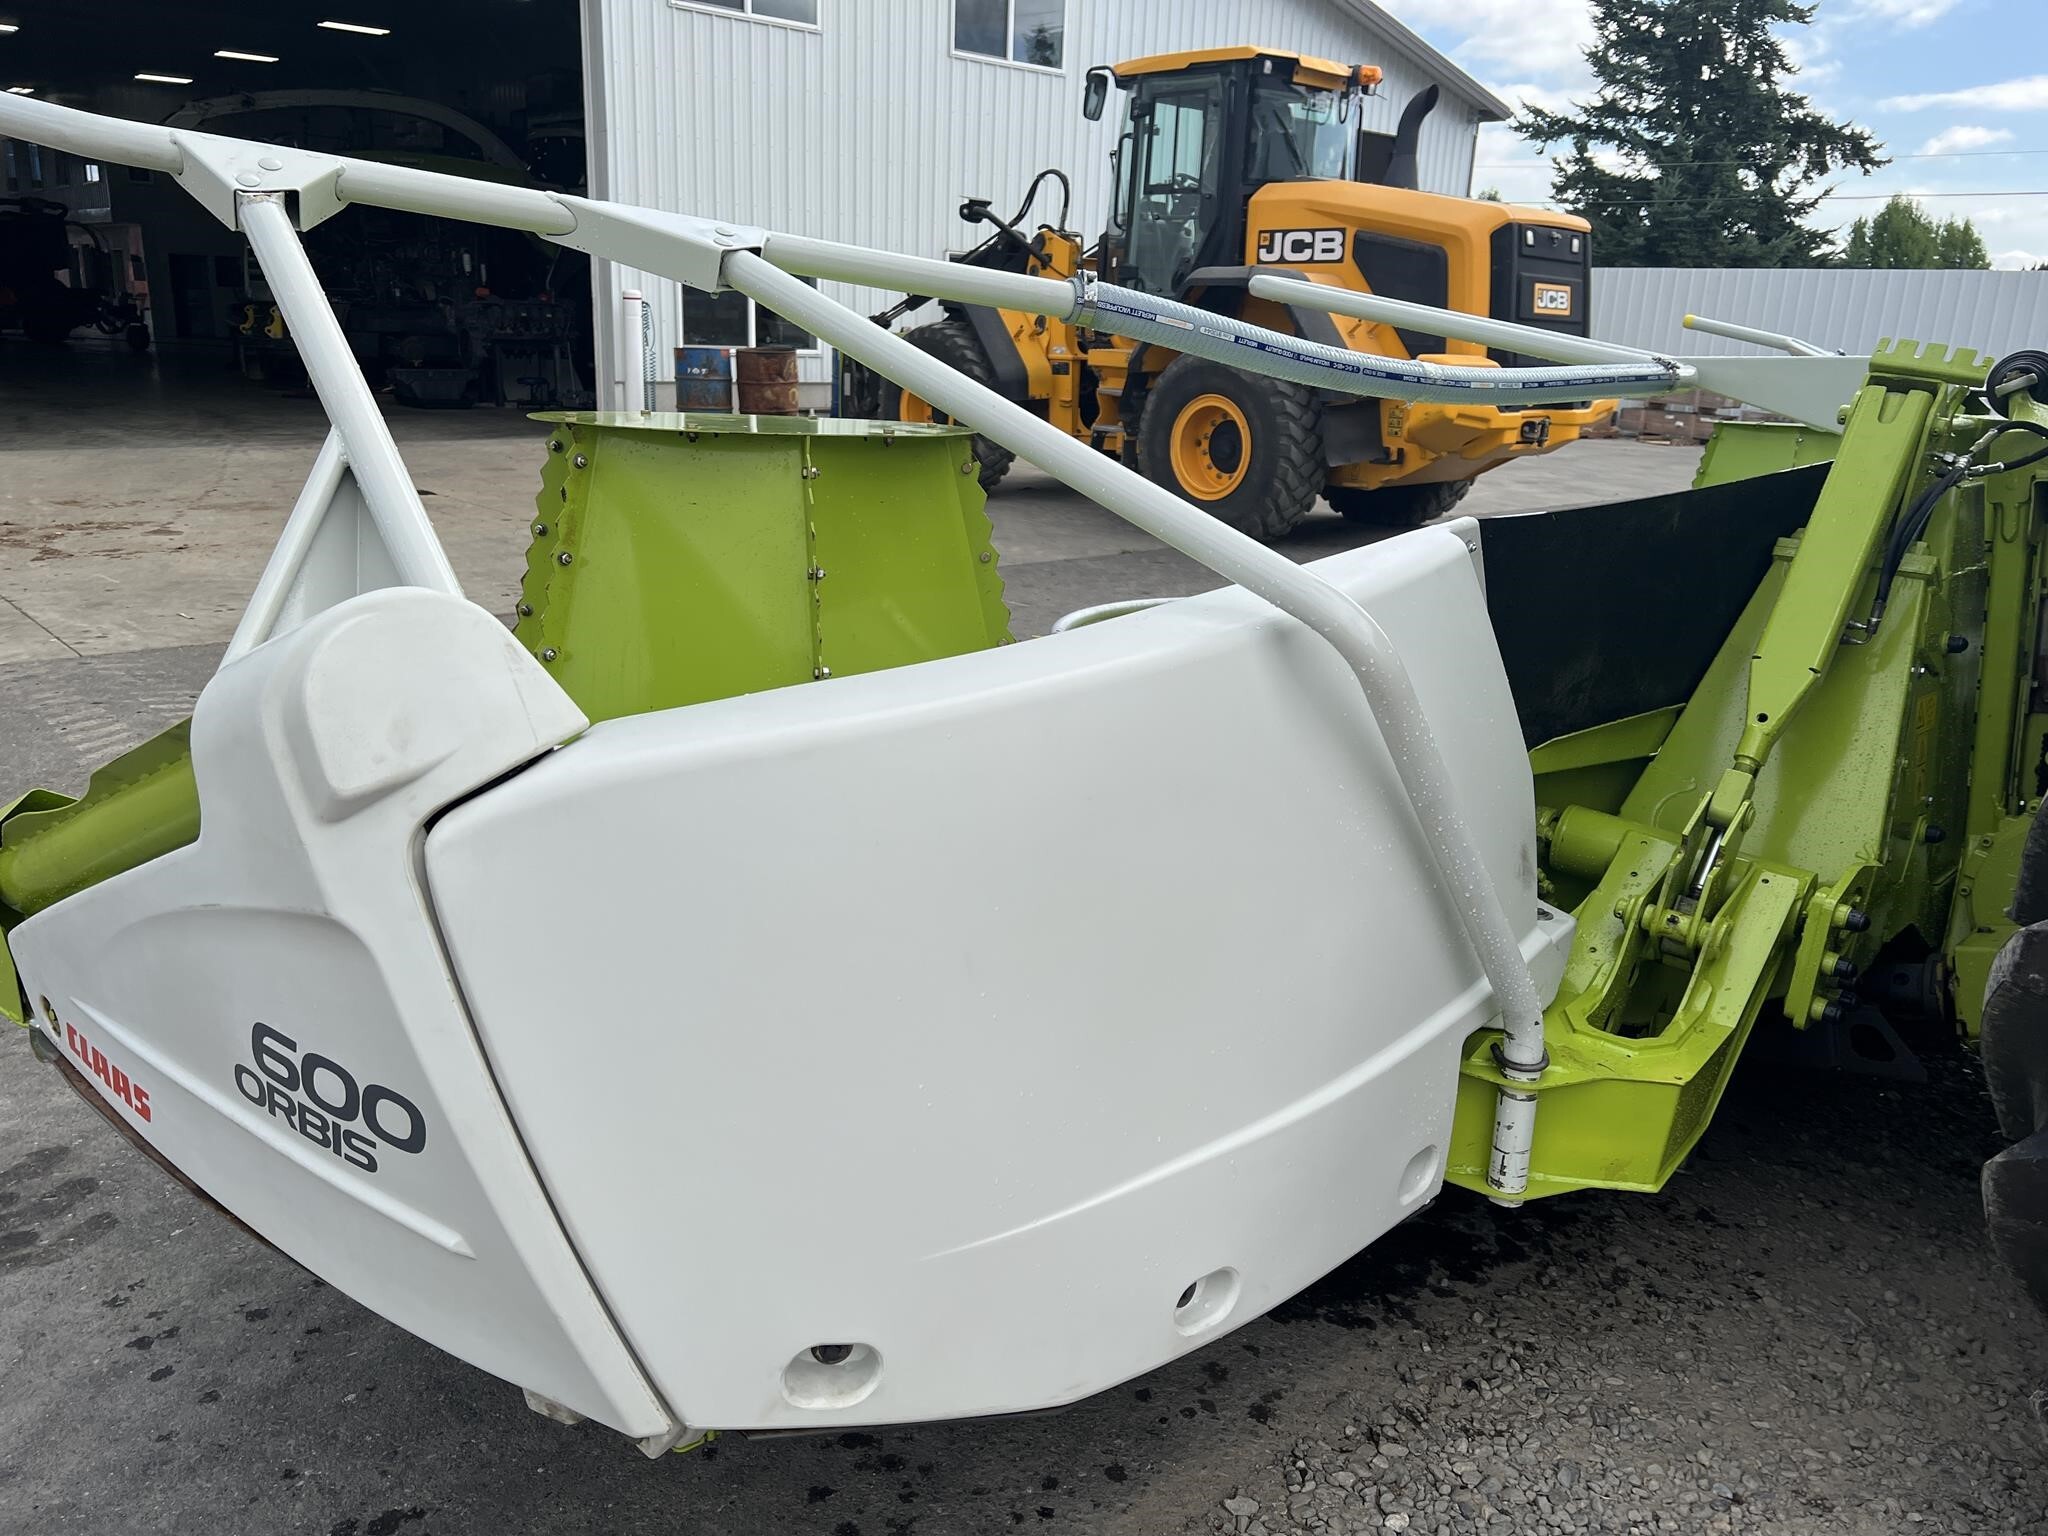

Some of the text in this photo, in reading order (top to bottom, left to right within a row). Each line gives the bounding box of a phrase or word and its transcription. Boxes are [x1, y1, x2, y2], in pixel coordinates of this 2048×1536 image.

[1258, 230, 1344, 262] JCB
[1537, 290, 1568, 309] JCB
[66, 1022, 151, 1123] CLAAS
[235, 1064, 377, 1173] ORBIS
[252, 1022, 426, 1154] 600
